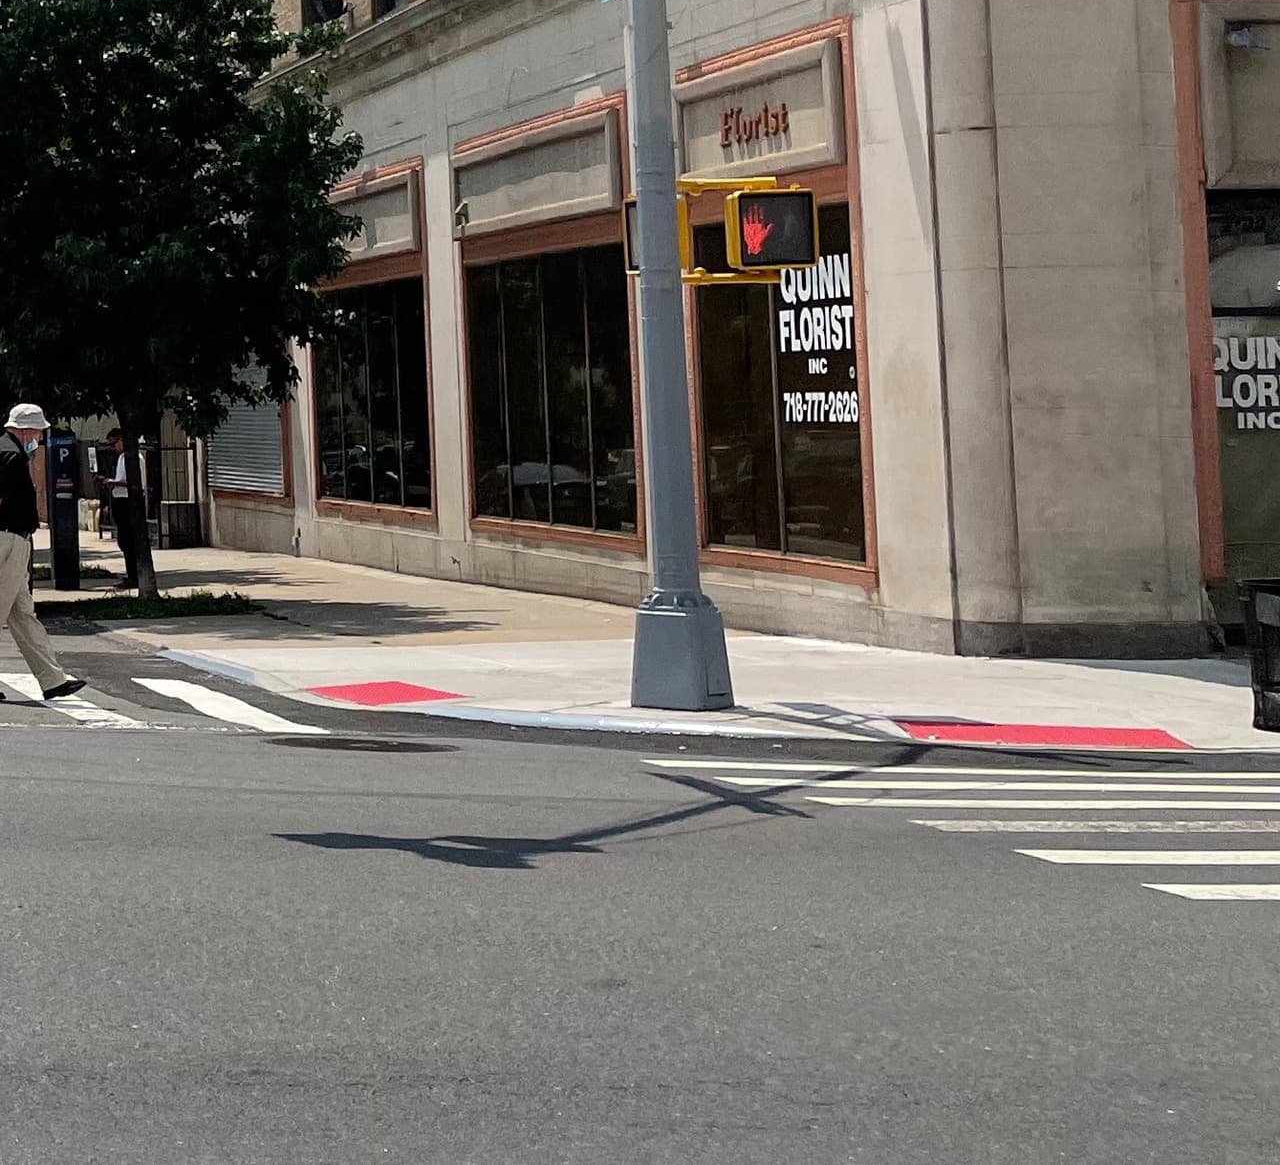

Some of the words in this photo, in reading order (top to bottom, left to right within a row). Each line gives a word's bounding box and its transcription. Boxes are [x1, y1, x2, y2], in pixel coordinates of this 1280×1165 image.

[720, 101, 789, 147] Florist
[780, 253, 850, 304] QUINN
[779, 305, 853, 352] FLORIST
[808, 358, 828, 374] INC
[783, 391, 859, 423] 718-777-2626
[1215, 374, 1280, 407] LOR
[59, 448, 70, 463] P
